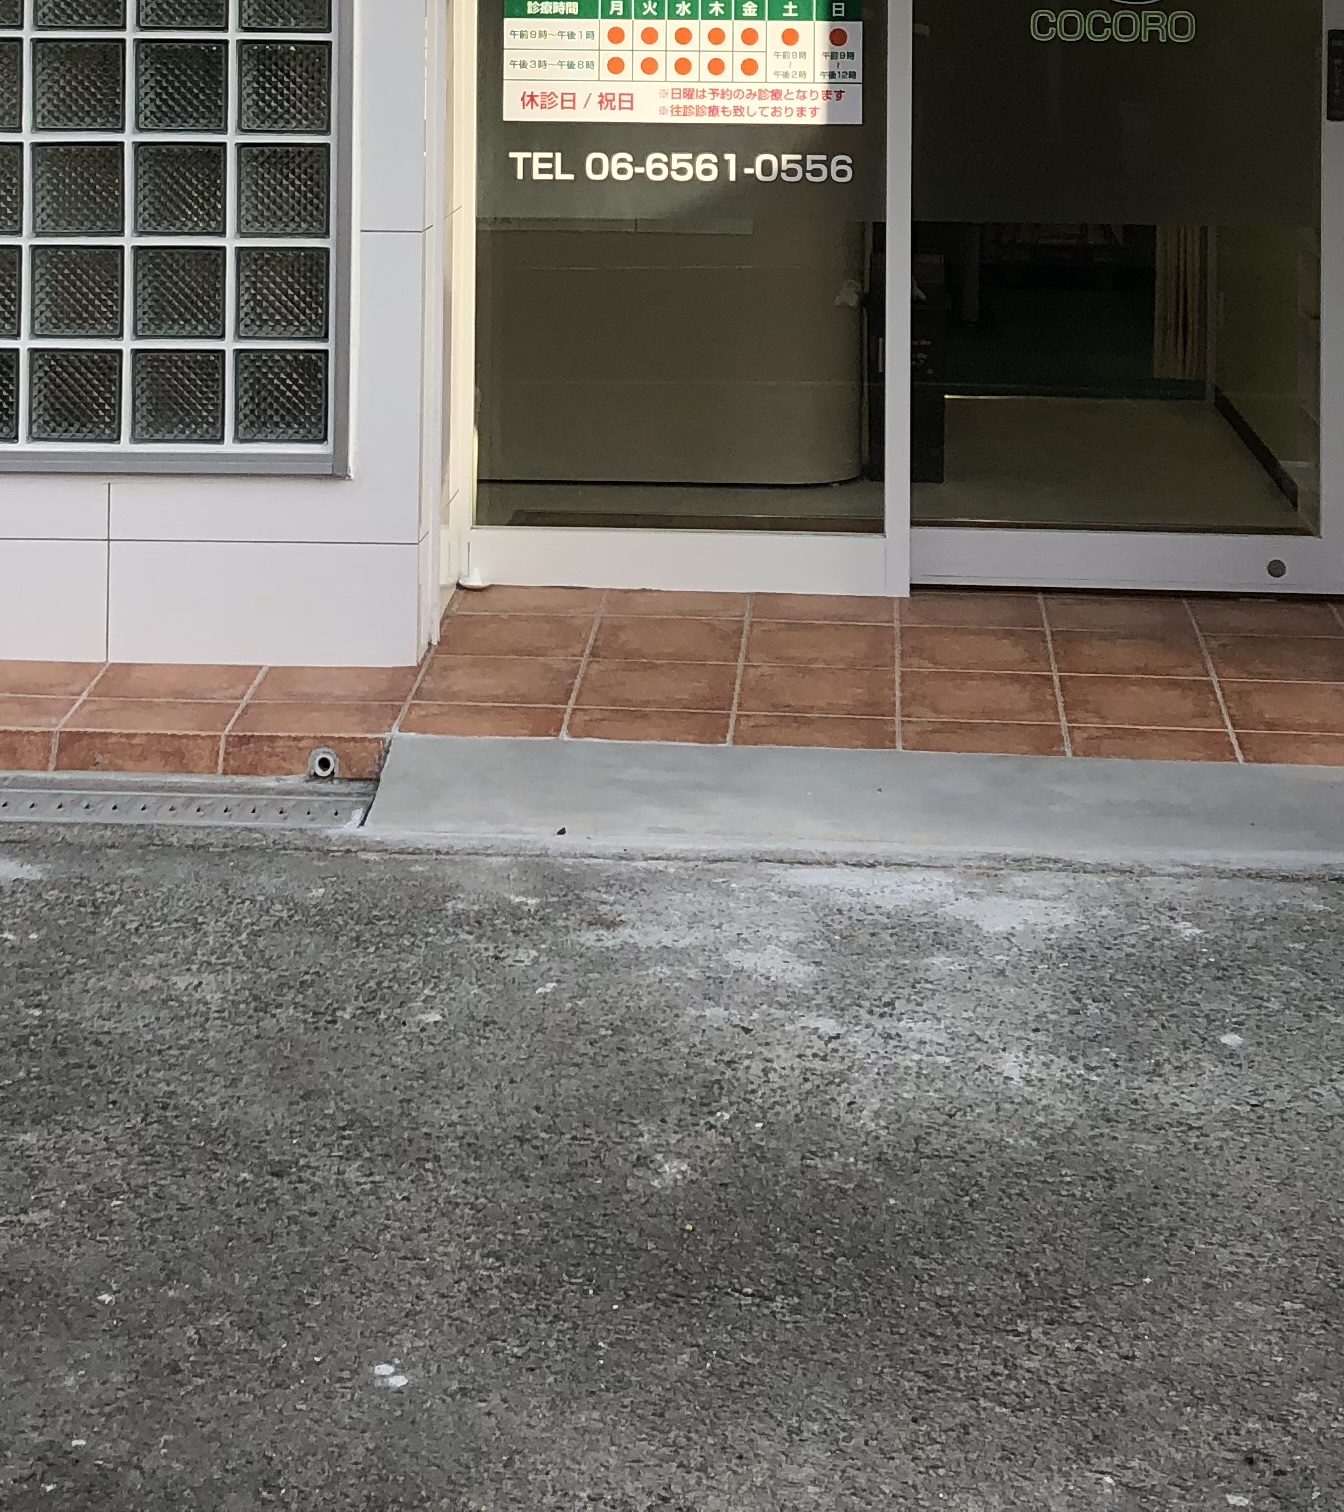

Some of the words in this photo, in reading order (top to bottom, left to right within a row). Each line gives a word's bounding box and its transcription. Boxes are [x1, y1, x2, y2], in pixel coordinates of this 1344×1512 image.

[526, 0, 579, 16] 診療時間
[609, 0, 624, 16] 月
[642, 0, 658, 16] 火
[675, 0, 692, 16] 水
[708, 1, 725, 17] 木
[742, 1, 758, 17] 金
[782, 1, 799, 17] 土
[832, 2, 845, 17] 日
[1030, 9, 1196, 43] COCORO
[508, 151, 575, 181] TEL
[585, 151, 853, 183] 06-6561-0556
